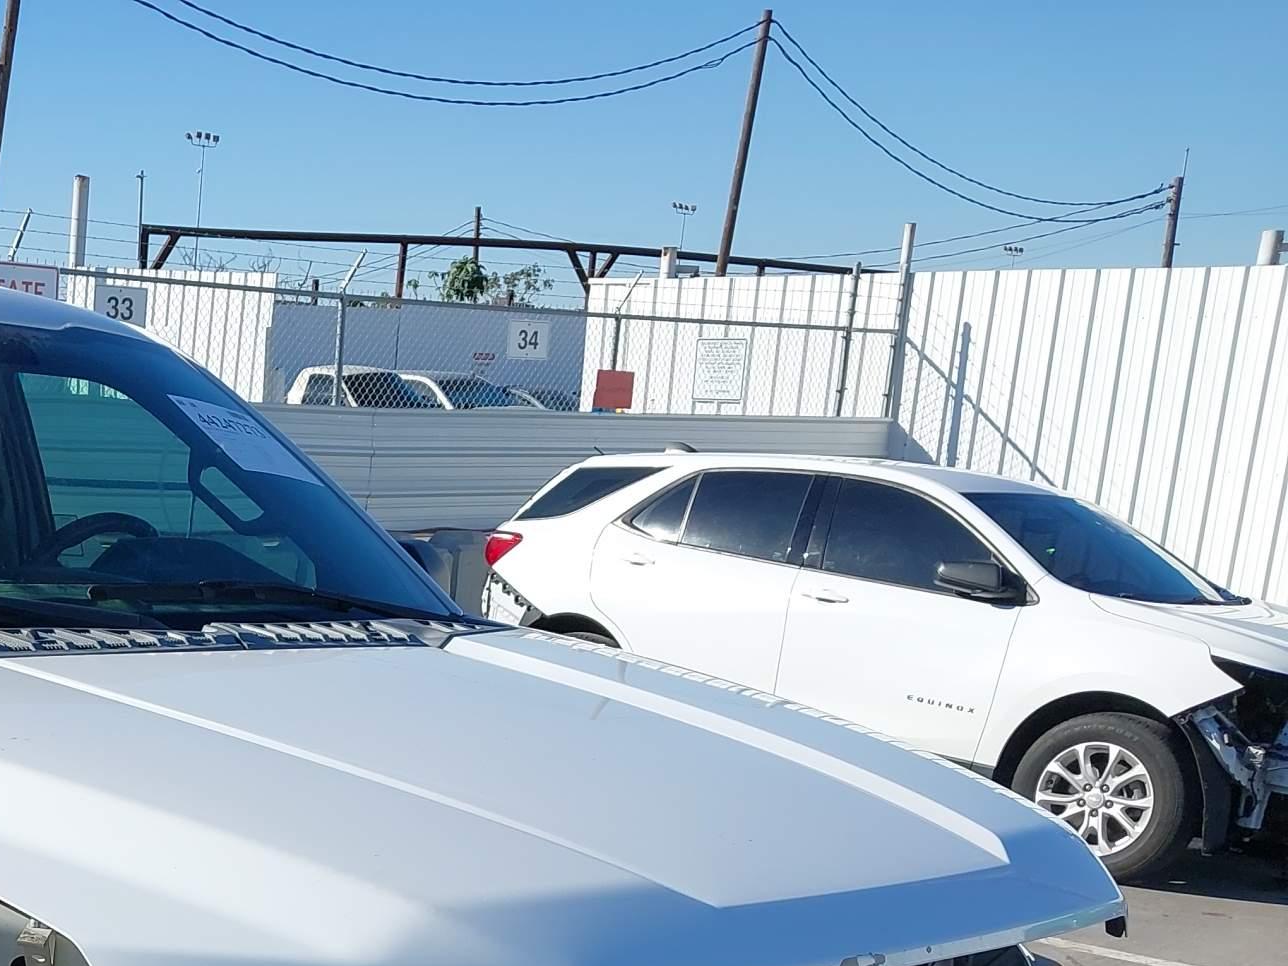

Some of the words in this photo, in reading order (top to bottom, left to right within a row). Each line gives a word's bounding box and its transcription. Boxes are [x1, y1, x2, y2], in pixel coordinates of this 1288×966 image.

[106, 296, 134, 321] 33
[517, 329, 540, 350] 34
[906, 694, 976, 715] EQUINOX
